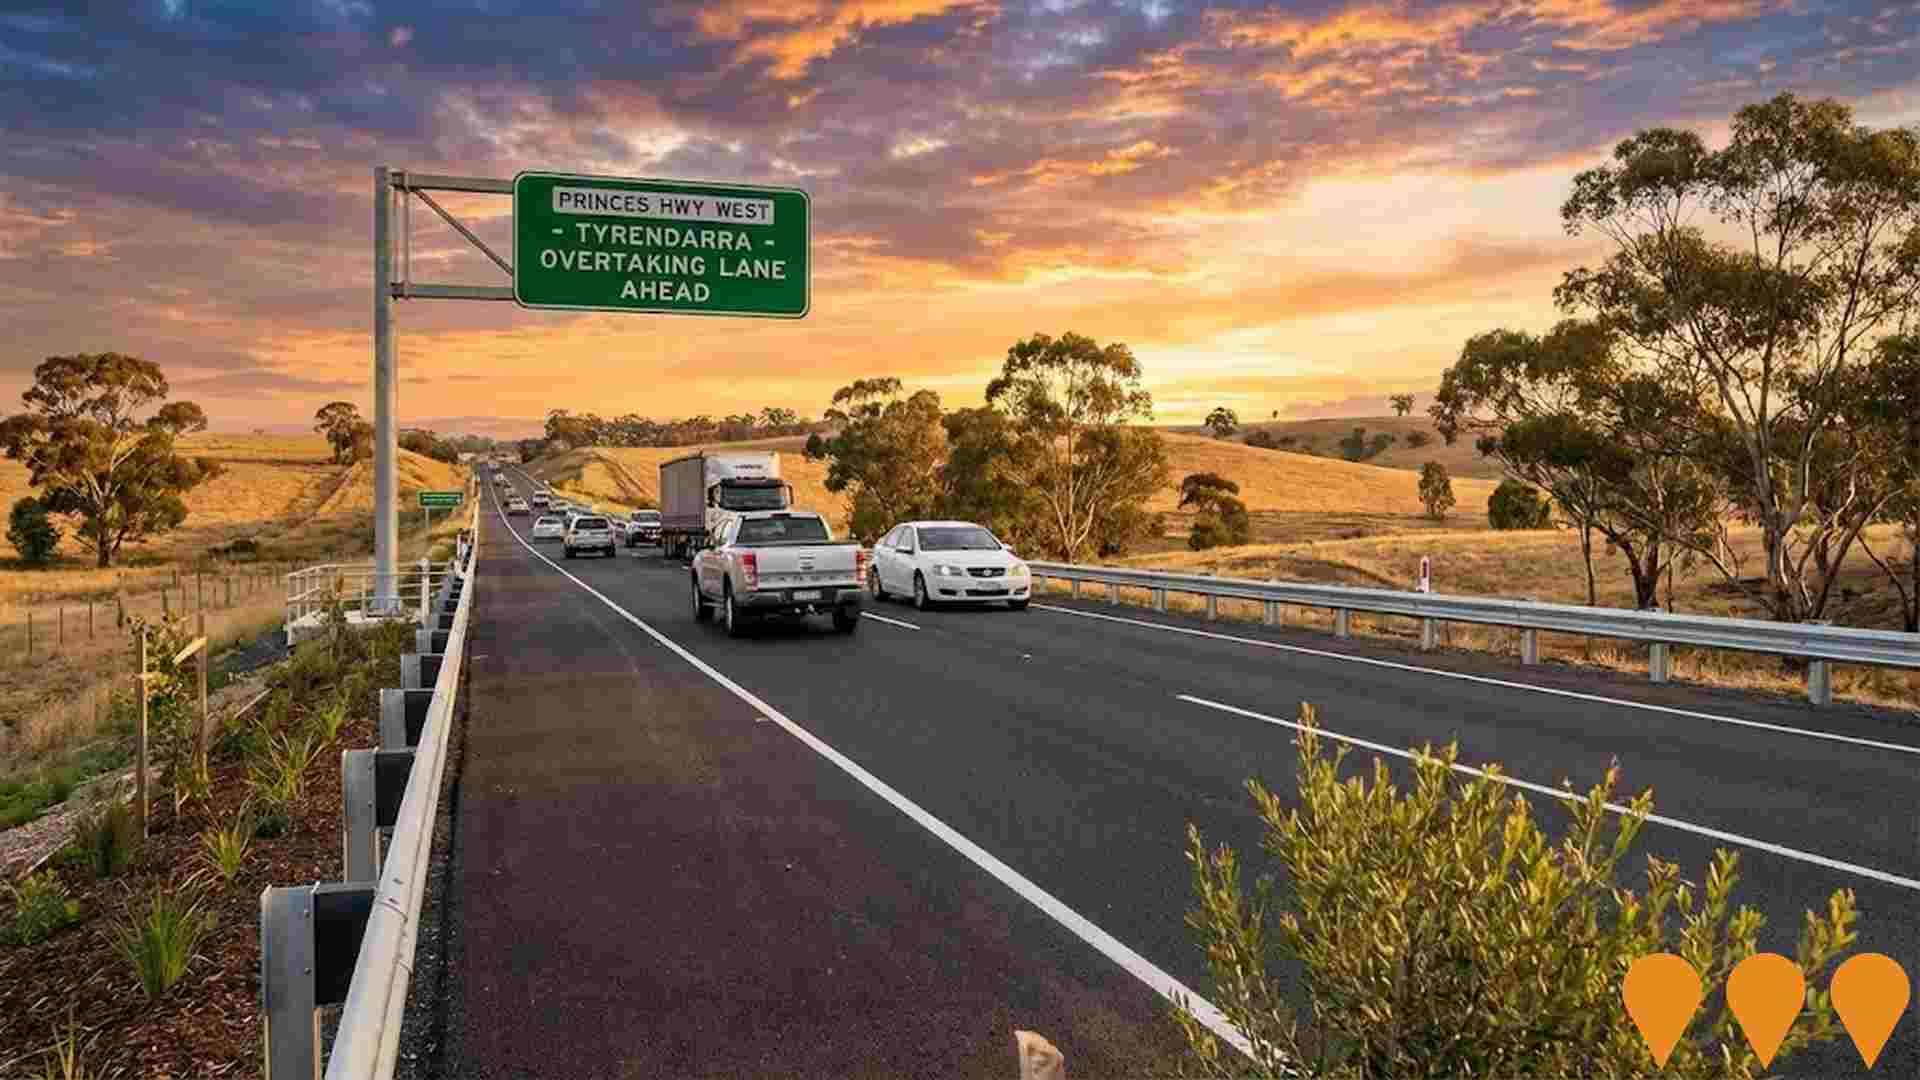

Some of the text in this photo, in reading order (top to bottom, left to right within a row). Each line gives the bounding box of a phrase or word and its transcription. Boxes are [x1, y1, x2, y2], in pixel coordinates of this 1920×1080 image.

[558, 192, 769, 220] PRINCES HWY WEST
[575, 222, 752, 251] TYRENDARRA
[540, 250, 787, 280] OVERTAKING LANE
[620, 280, 711, 303] AHEAD
